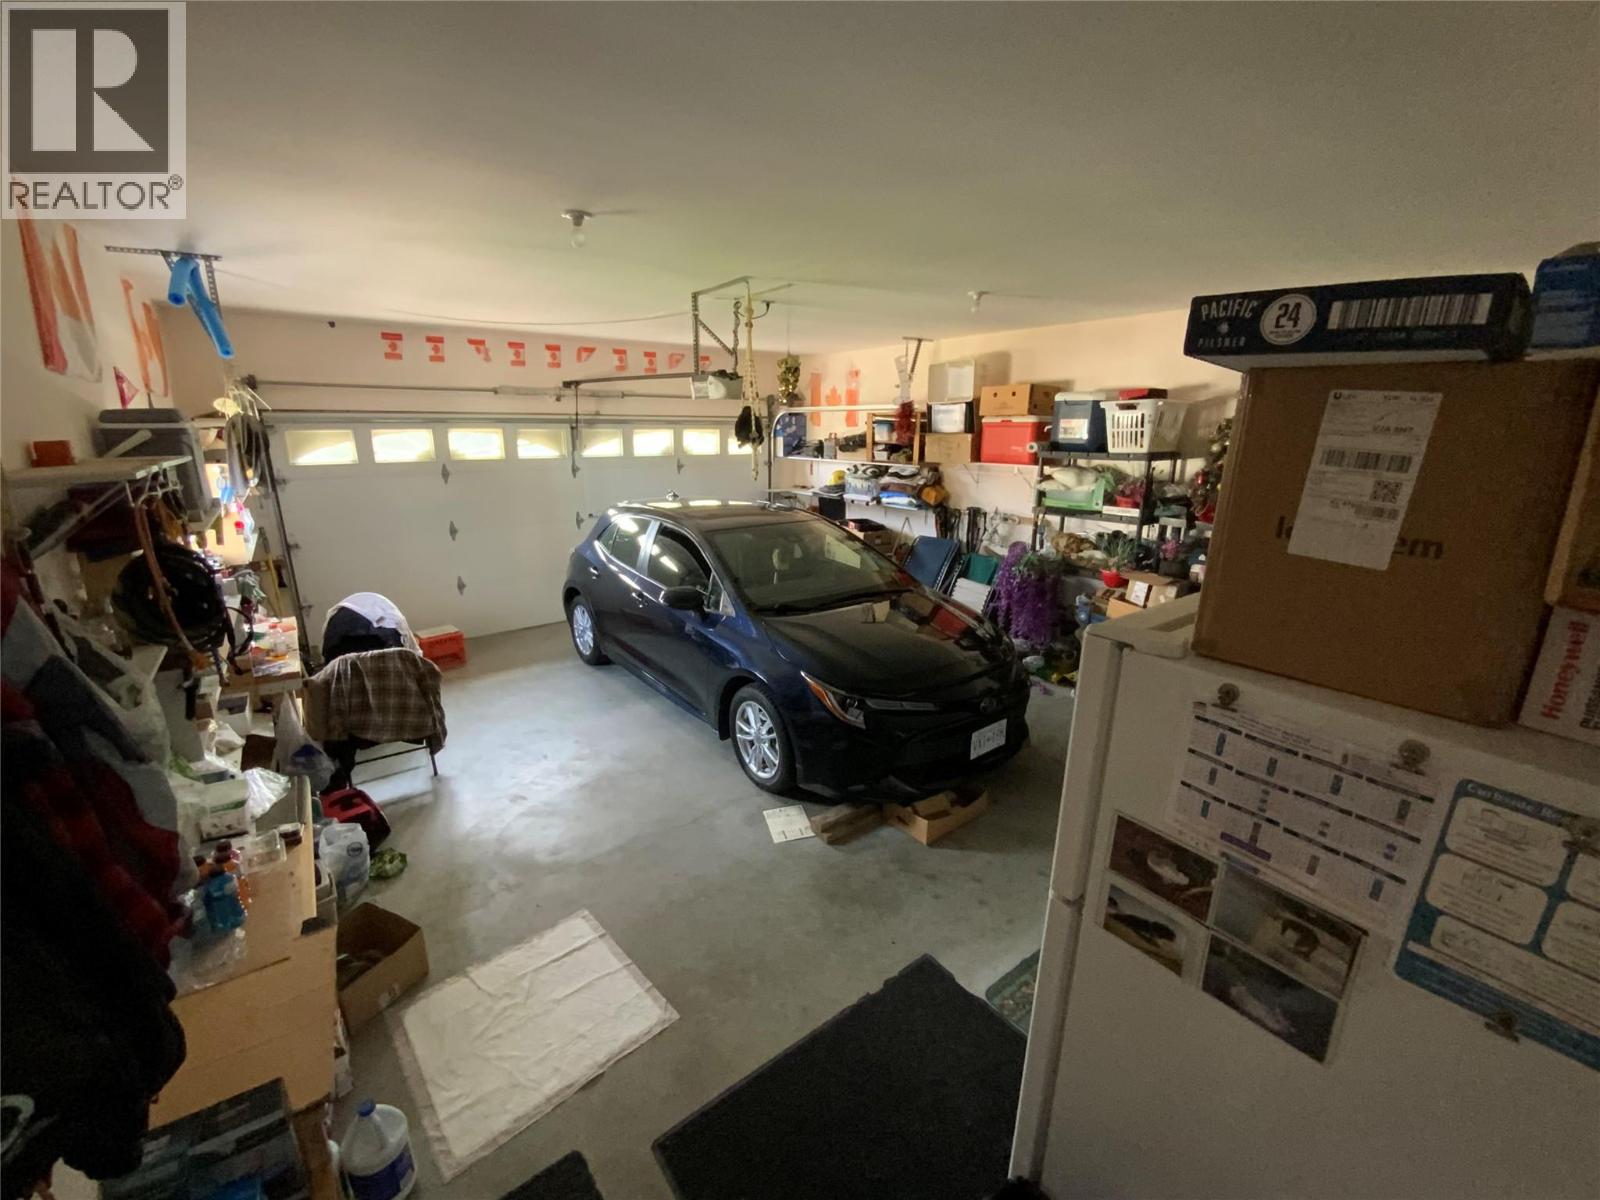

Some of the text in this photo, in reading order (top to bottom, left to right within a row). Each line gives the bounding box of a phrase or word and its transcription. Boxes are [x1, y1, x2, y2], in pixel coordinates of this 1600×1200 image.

[1200, 299, 1258, 321] PACIFIC
[1274, 302, 1302, 329] 24
[1198, 336, 1246, 348] PILSNER
[1541, 620, 1590, 721] Honeywell
